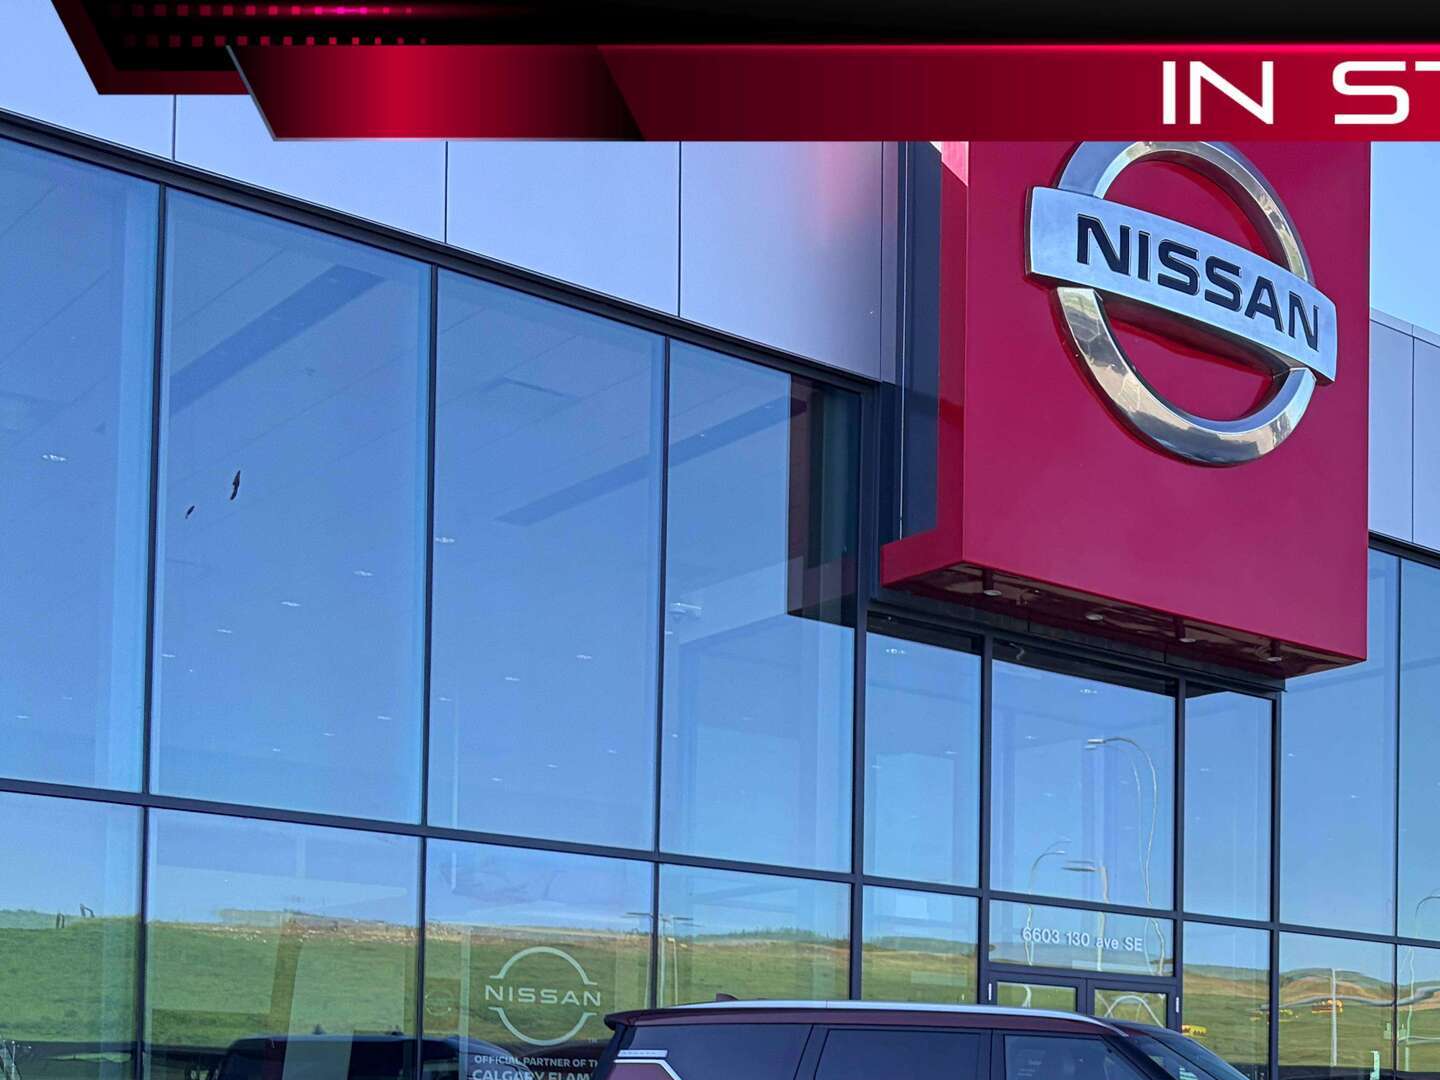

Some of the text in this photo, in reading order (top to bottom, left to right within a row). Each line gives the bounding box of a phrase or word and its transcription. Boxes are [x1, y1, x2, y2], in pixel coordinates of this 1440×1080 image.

[1076, 213, 1319, 352] NISSAN
[1022, 927, 1144, 952] 6603 130 ave SE
[485, 984, 601, 1007] NISSAN
[474, 1054, 521, 1066] OFFICIAL
[523, 1056, 571, 1068] PARTNER
[572, 1058, 586, 1068] OF
